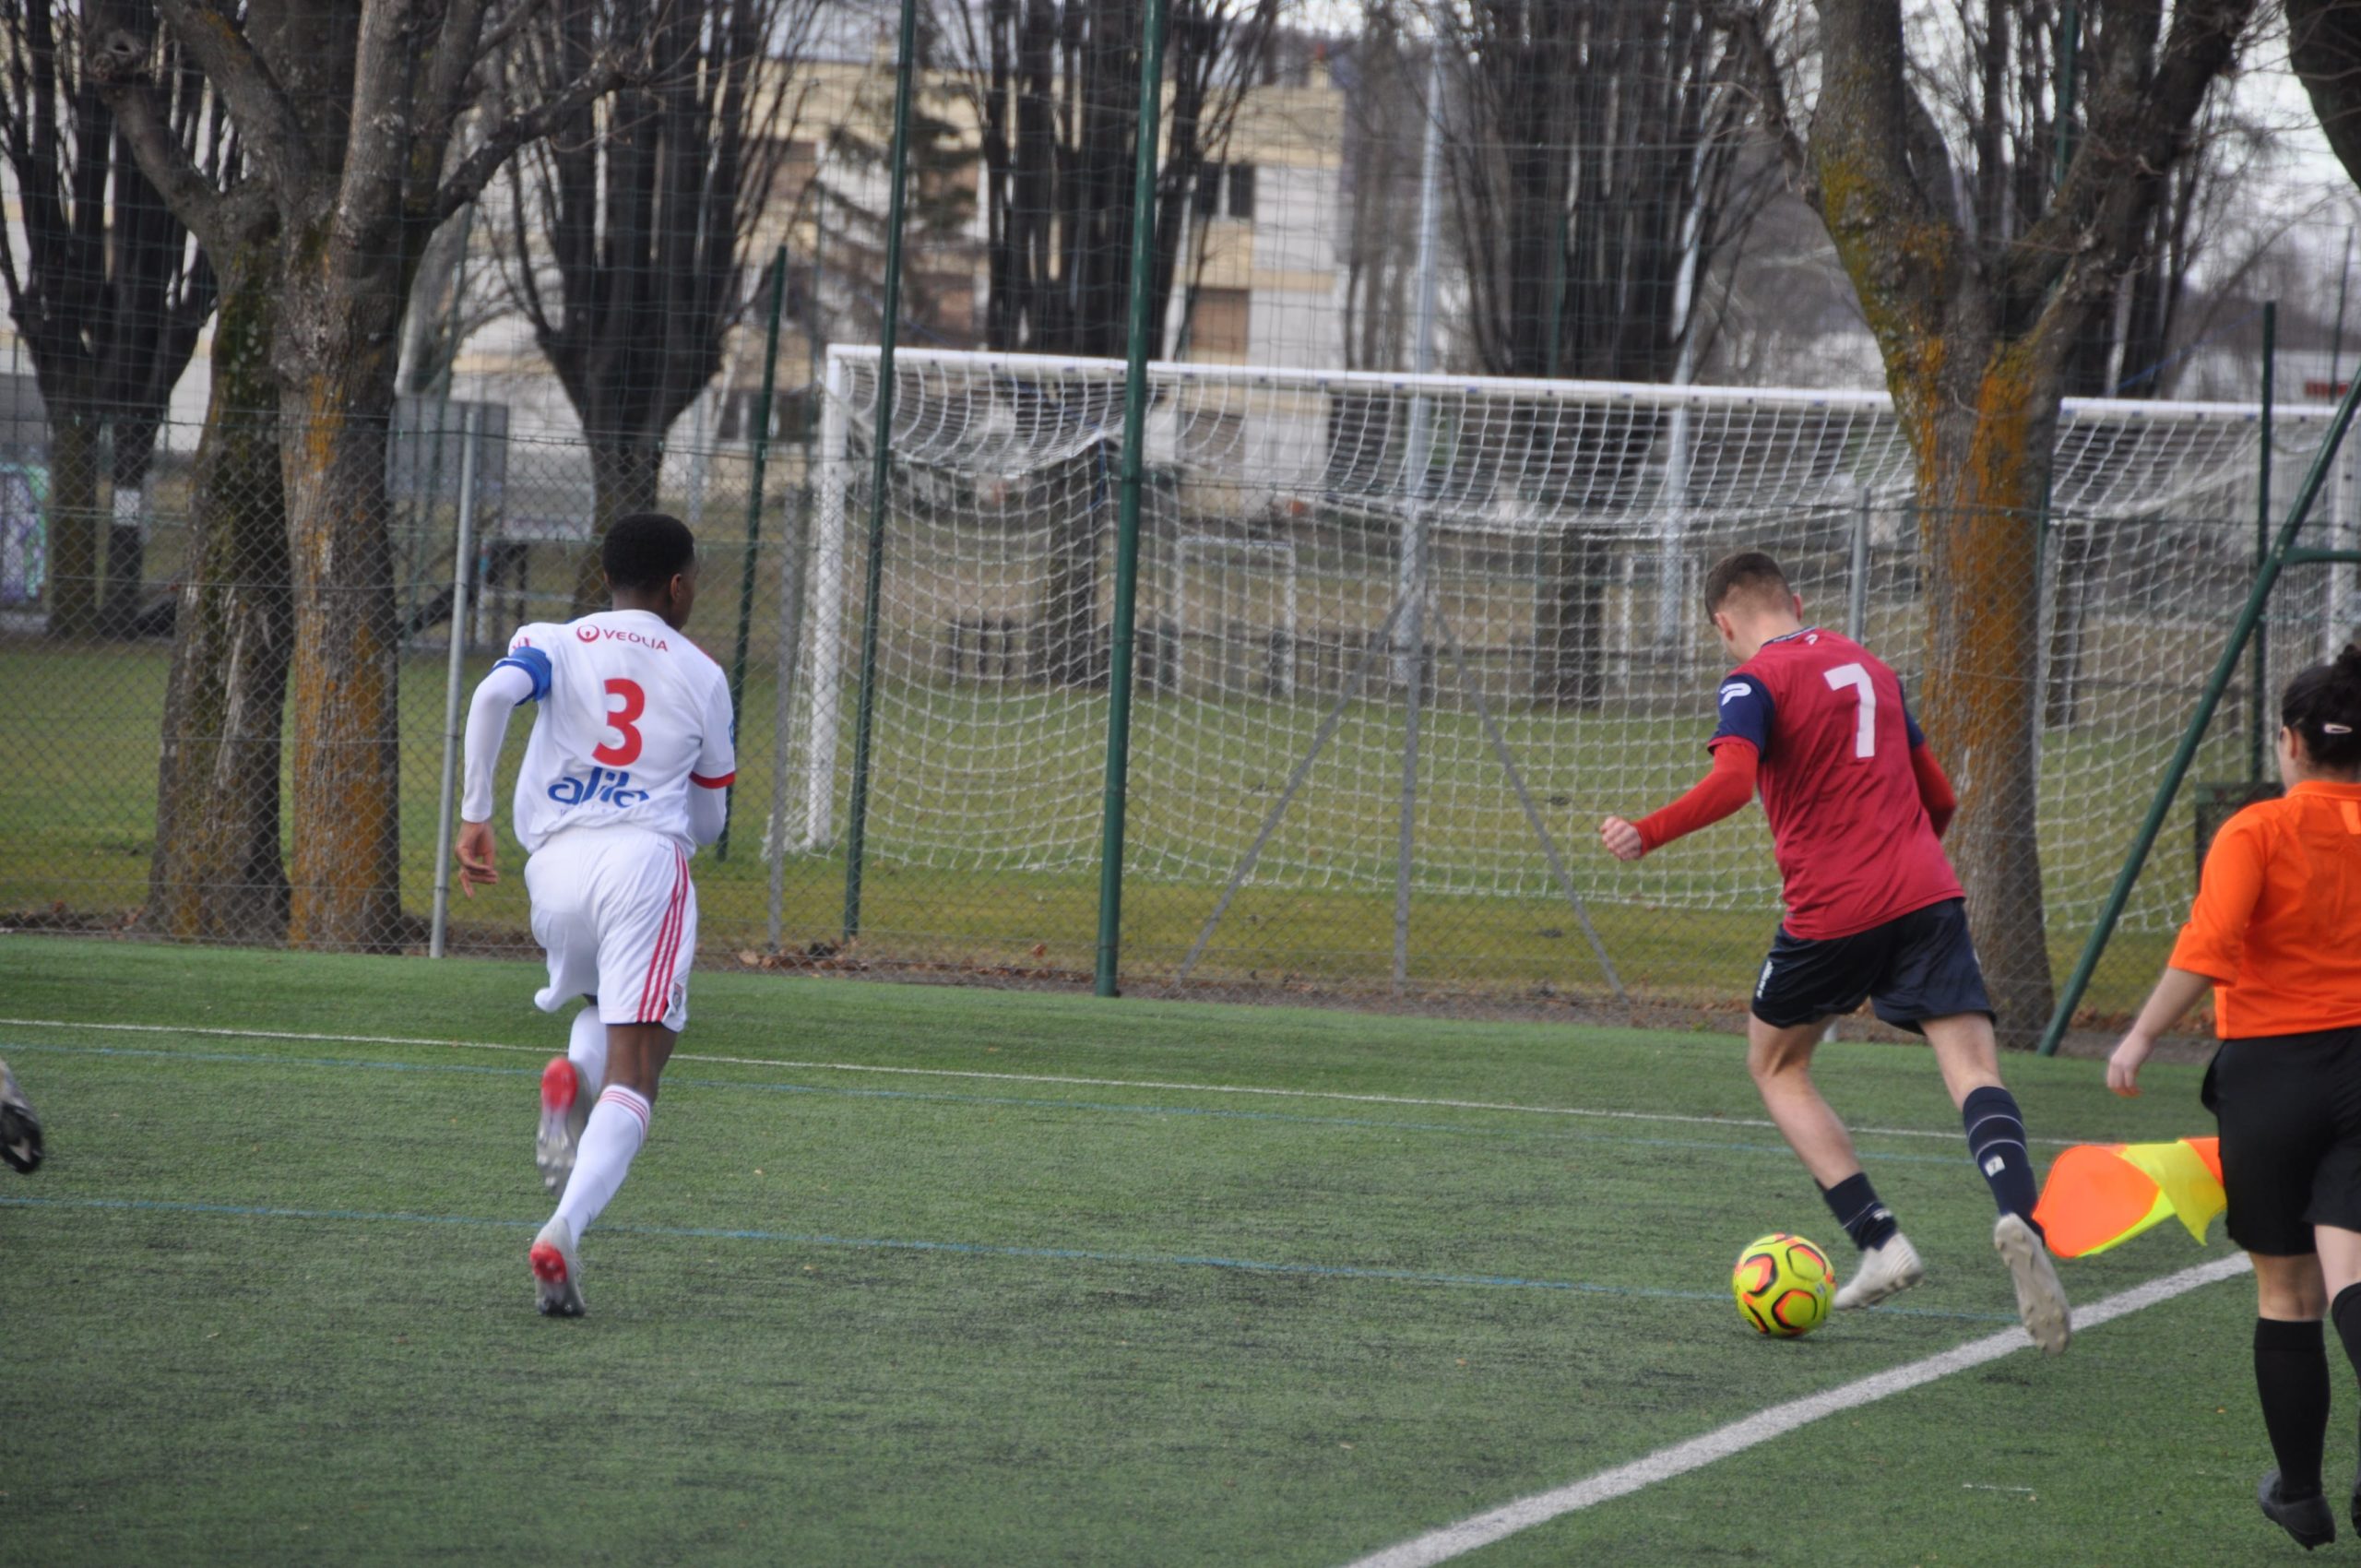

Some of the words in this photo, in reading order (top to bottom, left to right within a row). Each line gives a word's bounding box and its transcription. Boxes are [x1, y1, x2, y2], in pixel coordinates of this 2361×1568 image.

[603, 628, 669, 652] VEOLIA
[591, 678, 646, 766] 3
[1823, 662, 1877, 759] 7
